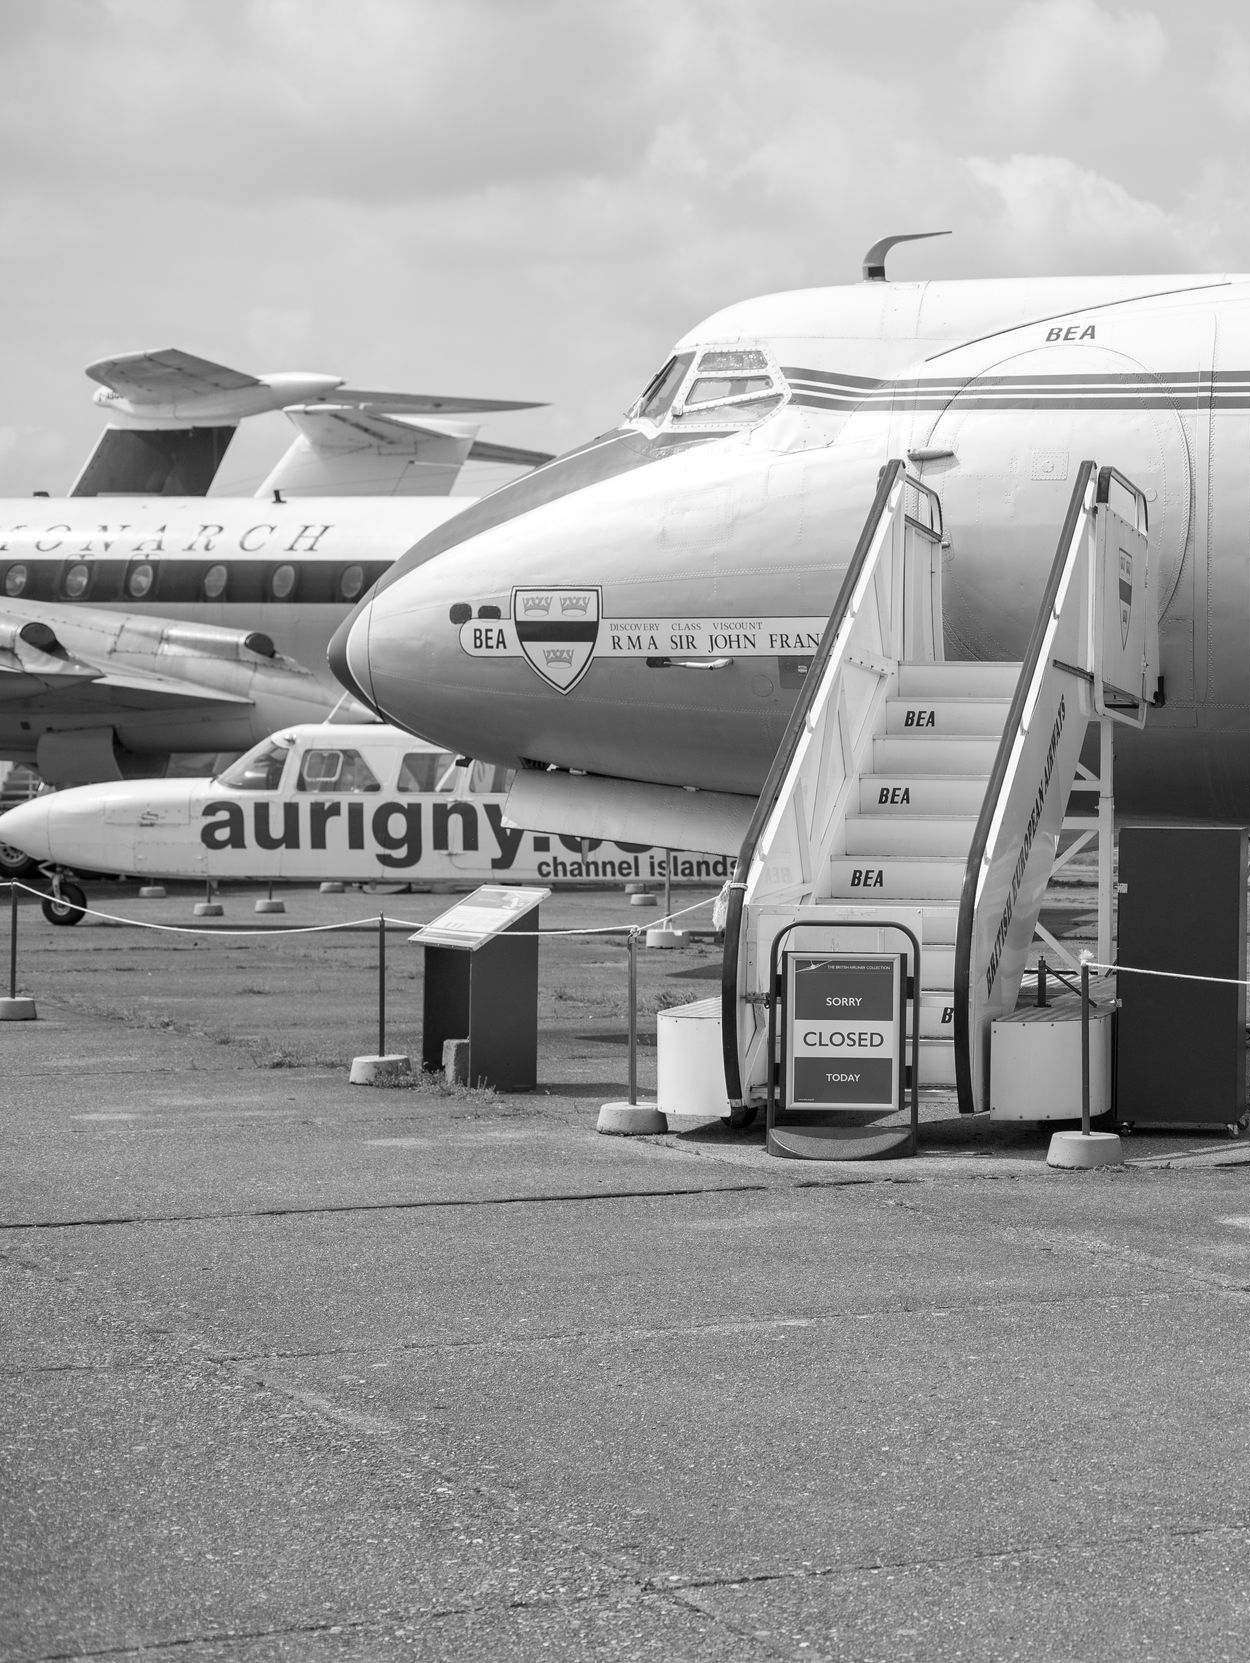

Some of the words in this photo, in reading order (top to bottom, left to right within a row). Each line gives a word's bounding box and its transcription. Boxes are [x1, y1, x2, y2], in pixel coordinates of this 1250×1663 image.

[1045, 324, 1096, 342] BEA
[610, 622, 660, 632] DISCOVERY
[671, 622, 701, 632] CLASS
[713, 621, 763, 632] VISCOUNT
[473, 628, 507, 649] BEA
[670, 634, 698, 650] SIR
[708, 633, 757, 653] JOHN
[768, 633, 822, 649] FRAN
[904, 710, 936, 727] BEA
[878, 787, 911, 805] BEA
[537, 856, 640, 877] channel
[650, 855, 738, 877] islands
[850, 869, 884, 888] BEA
[986, 891, 1013, 1000] BRITISH
[1012, 779, 1045, 905] EUROPEAN
[826, 997, 863, 1007] SORRY
[803, 1031, 884, 1047] CLOSED
[826, 1073, 860, 1082] TODAY
